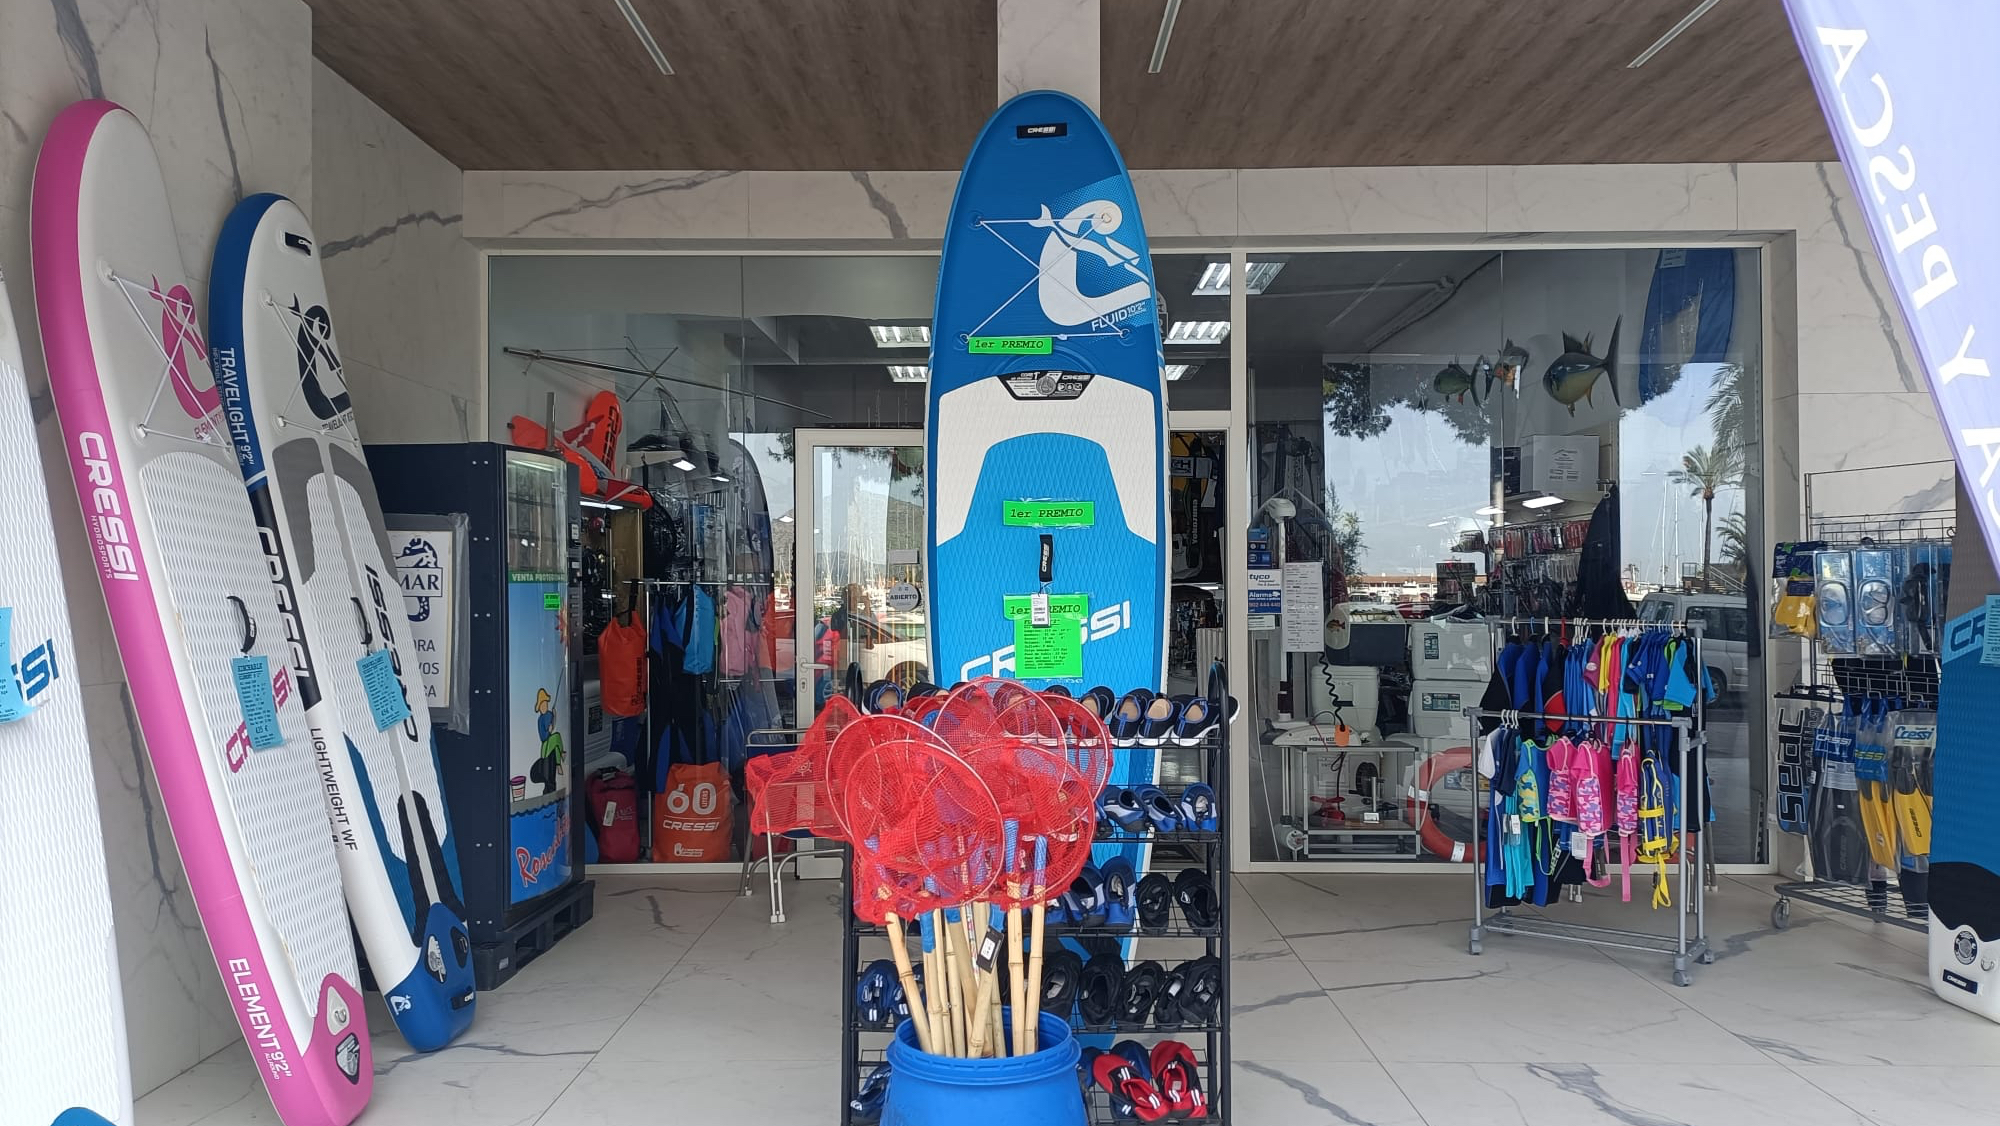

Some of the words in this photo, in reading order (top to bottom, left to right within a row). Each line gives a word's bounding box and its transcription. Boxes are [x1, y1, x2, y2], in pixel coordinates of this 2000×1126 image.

[975, 338, 996, 350] 1er
[1001, 338, 1044, 350] PREMIO
[1091, 310, 1128, 332] FLUID
[221, 347, 250, 446] TRAVELIGHT
[79, 432, 139, 581] CRESSI
[1010, 507, 1032, 519] 1er
[1038, 506, 1084, 519] PREMIO
[91, 515, 113, 580] HYDROSPORTS
[1777, 707, 1807, 824] seac
[1894, 725, 1935, 741] Cressi
[311, 728, 349, 827] LIGHTWEIGHT
[341, 829, 358, 851] WF
[662, 819, 720, 832] CRESSI
[229, 957, 280, 1051] ELEMENT
